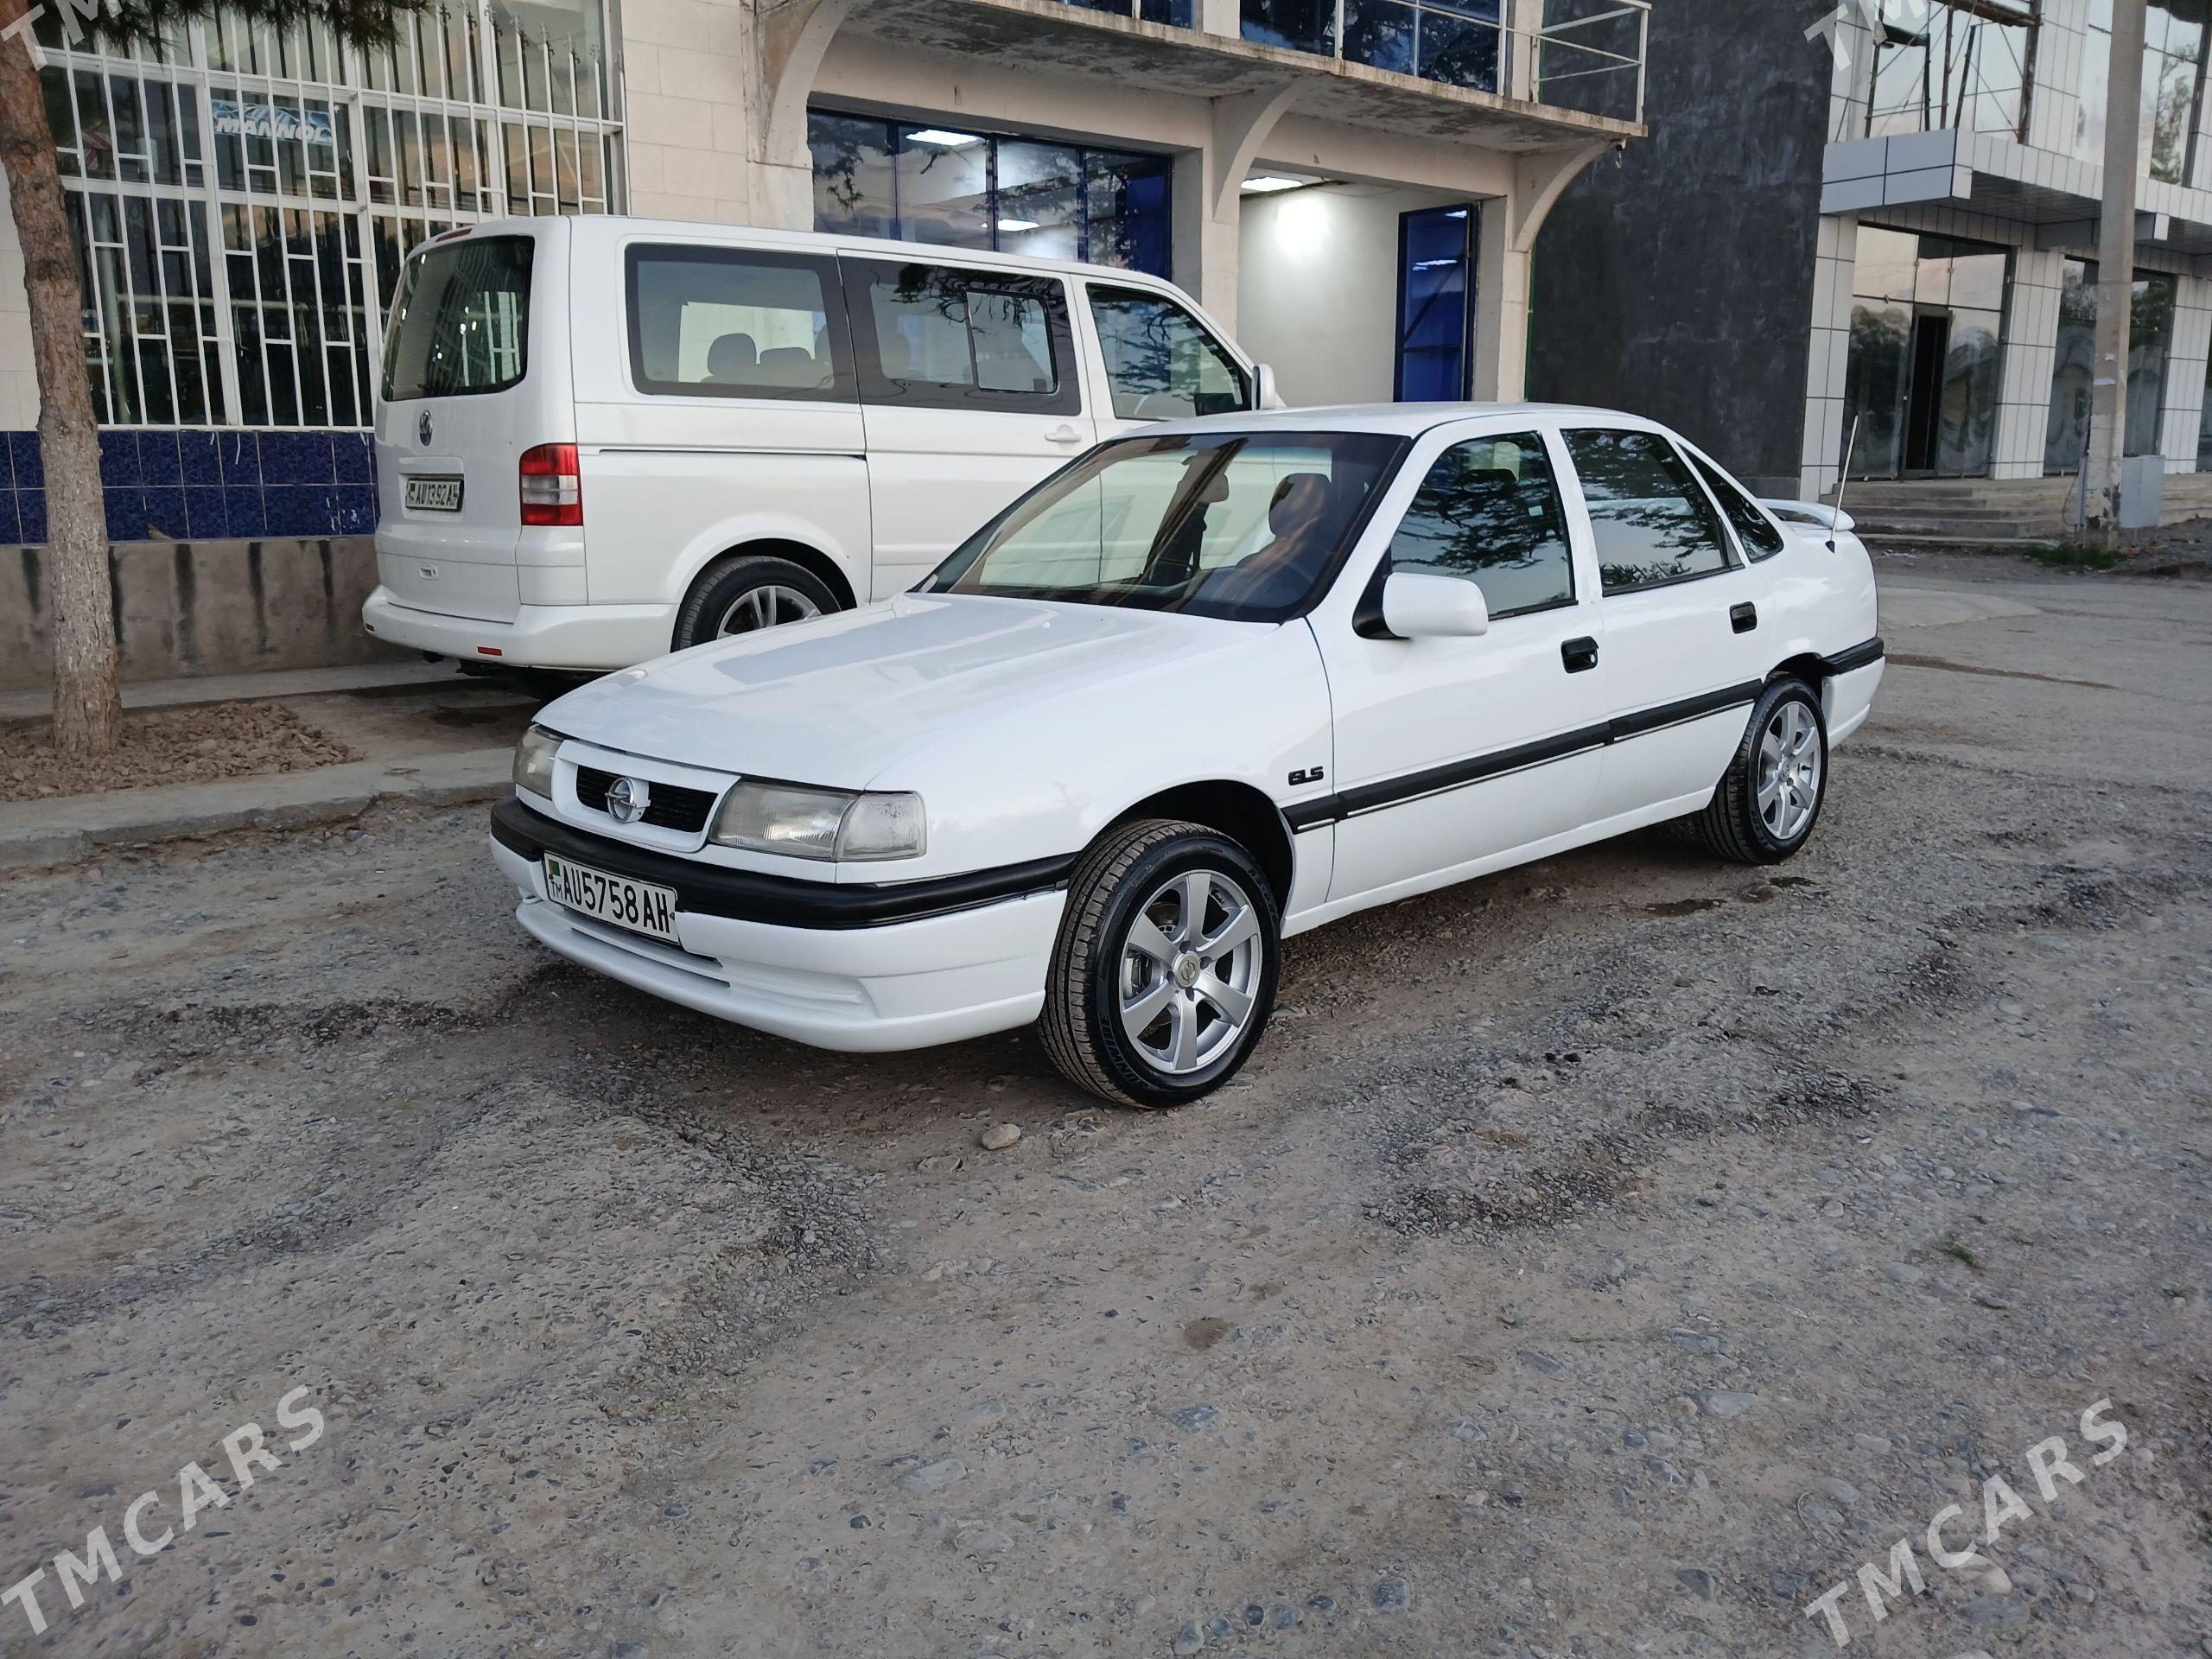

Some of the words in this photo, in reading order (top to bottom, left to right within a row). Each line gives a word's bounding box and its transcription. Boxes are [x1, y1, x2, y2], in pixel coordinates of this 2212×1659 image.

[217, 117, 334, 142] MANNOL
[551, 880, 563, 899] TM
[563, 865, 671, 934] AU5758AH
